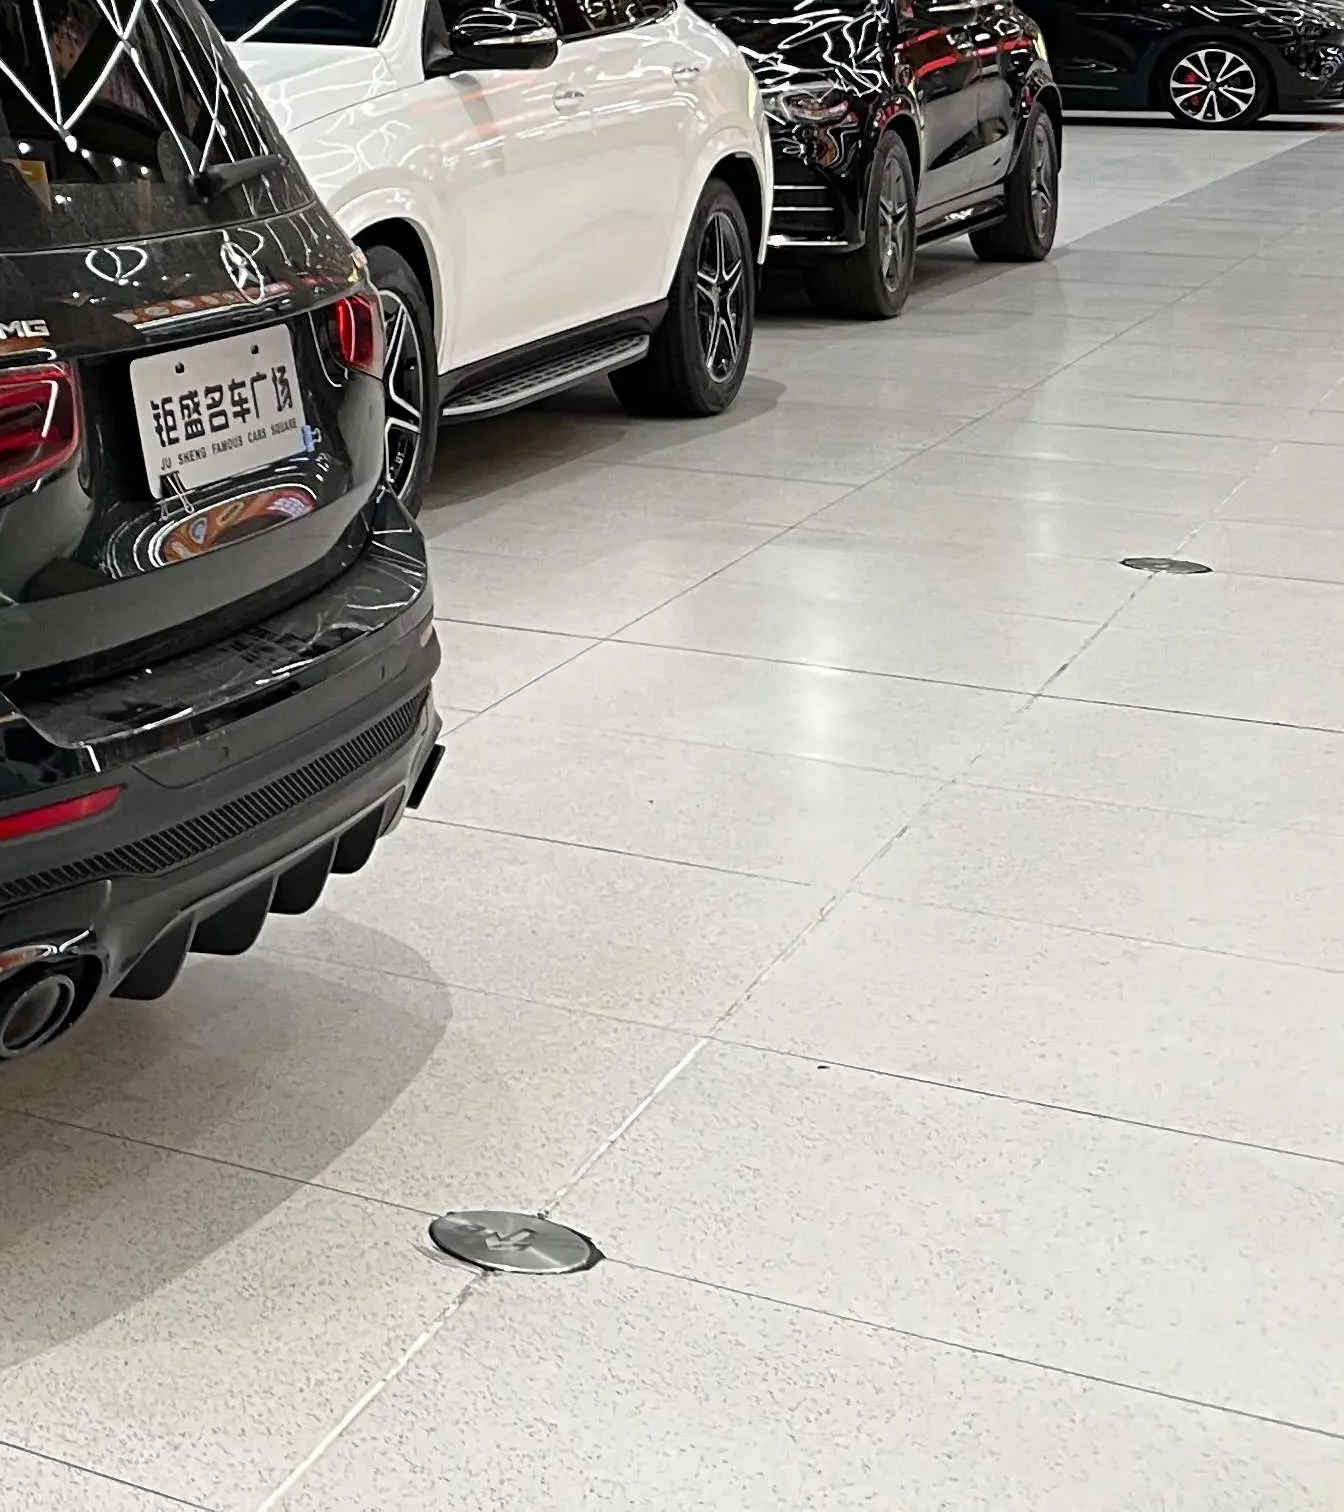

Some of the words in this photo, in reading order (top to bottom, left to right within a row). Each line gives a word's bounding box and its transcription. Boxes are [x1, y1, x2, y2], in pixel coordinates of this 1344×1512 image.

[160, 456, 173, 471] JU
[178, 446, 207, 466] SHENG
[212, 436, 243, 455] FAMOUS
[247, 429, 267, 444] CARS
[271, 417, 298, 436] SQUARE
